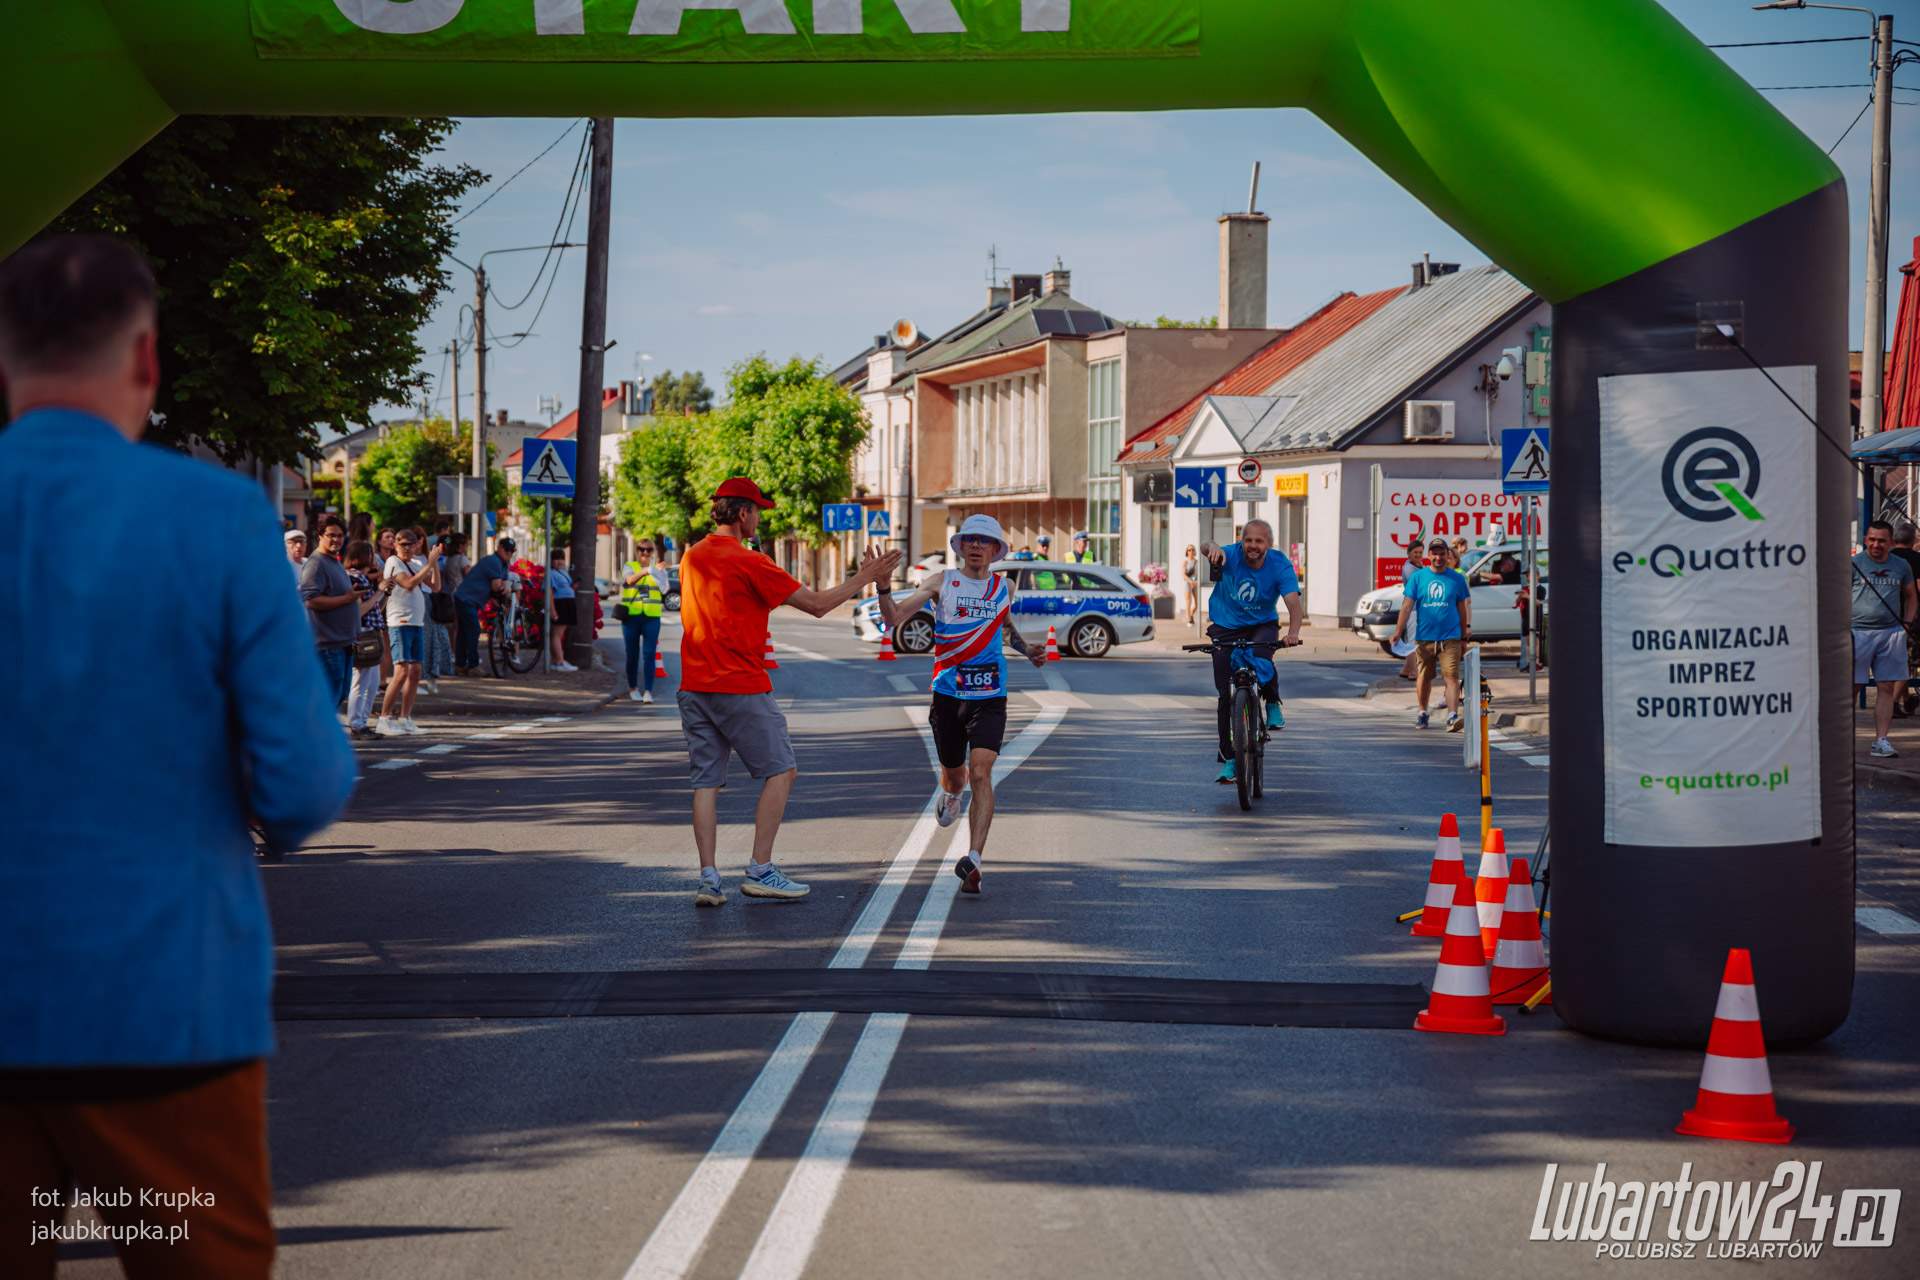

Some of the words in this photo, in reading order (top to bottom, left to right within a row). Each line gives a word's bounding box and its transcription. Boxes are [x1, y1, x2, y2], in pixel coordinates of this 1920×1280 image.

[957, 596, 997, 609] NIEMCE
[1108, 600, 1130, 610] D910
[968, 607, 997, 619] TEAM
[1632, 625, 1789, 650] ORGANIZACJA
[965, 672, 993, 686] 168
[1669, 661, 1755, 684] IMPREZ
[1637, 692, 1792, 718] SPORTOWYCH
[1640, 766, 1789, 795] e-quattro.pl
